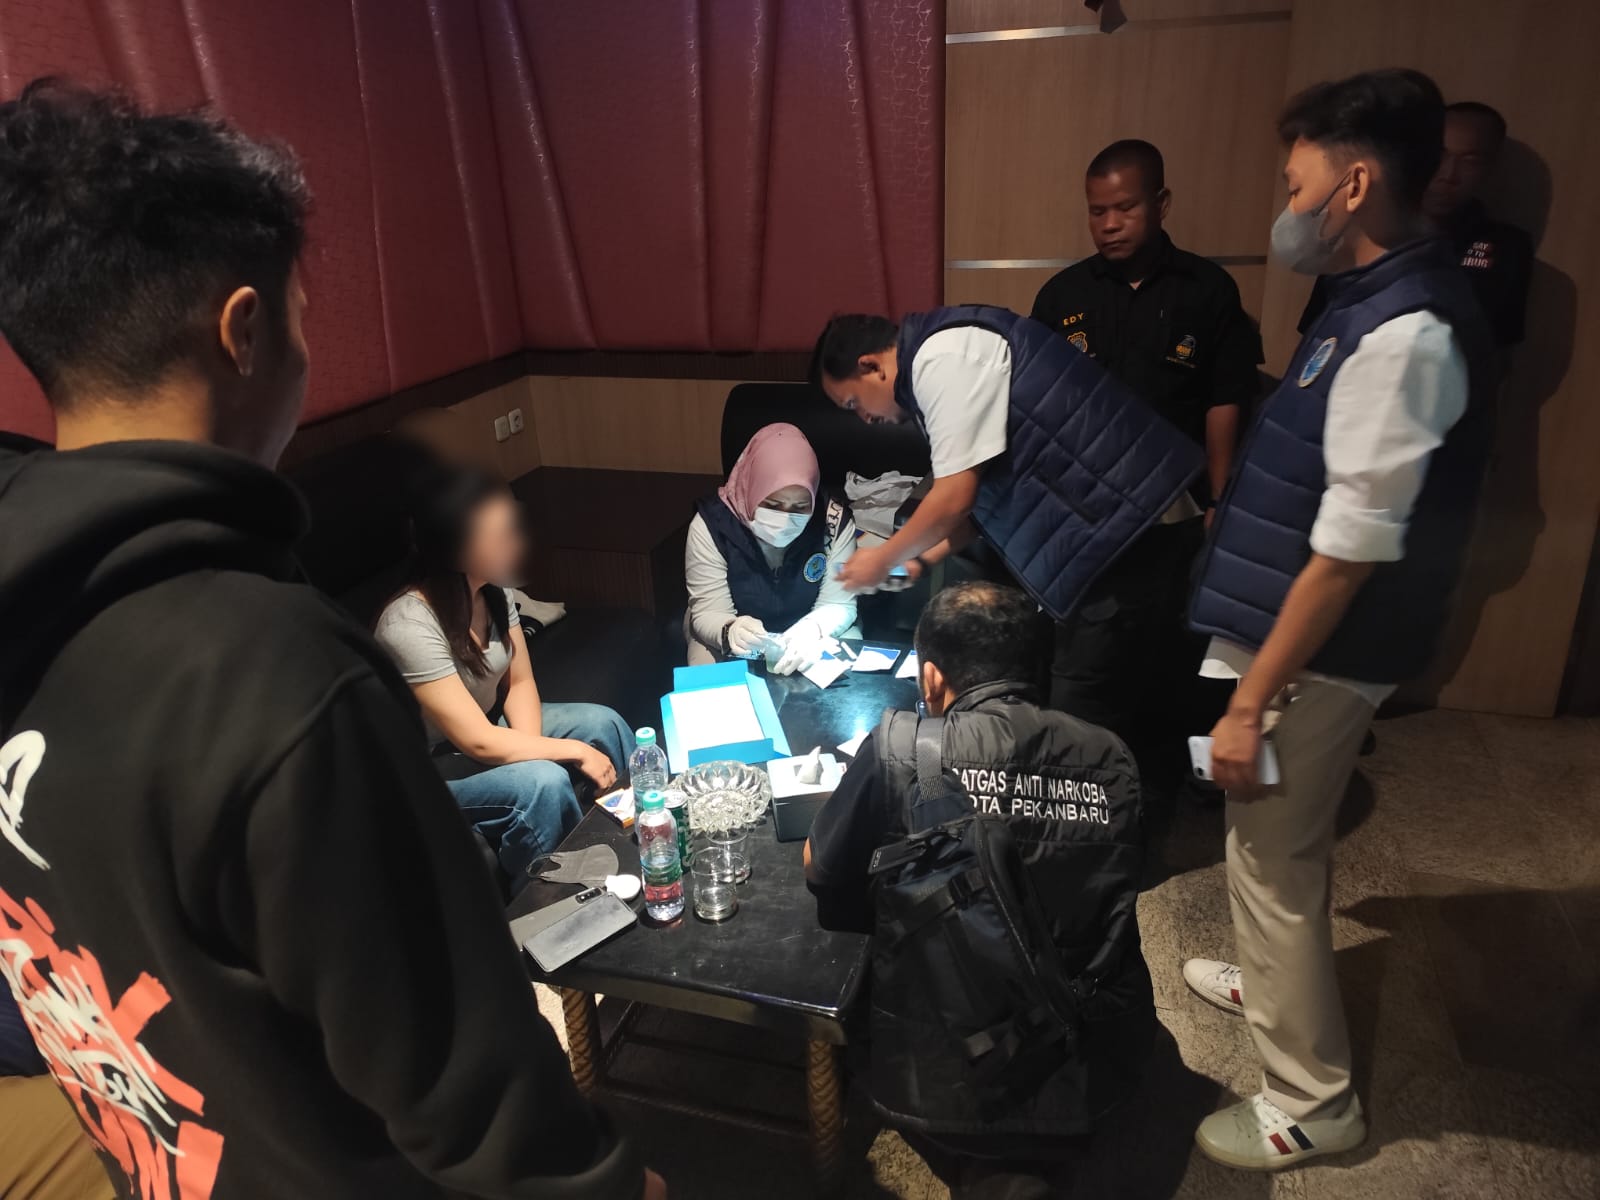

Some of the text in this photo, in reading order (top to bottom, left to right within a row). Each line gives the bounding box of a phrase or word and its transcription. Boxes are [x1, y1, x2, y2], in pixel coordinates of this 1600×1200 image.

[1063, 312, 1085, 326] EDY
[1013, 773, 1043, 798] ANTI
[1047, 777, 1109, 805] NARKOBA
[1011, 798, 1110, 825] PEKANBARU
